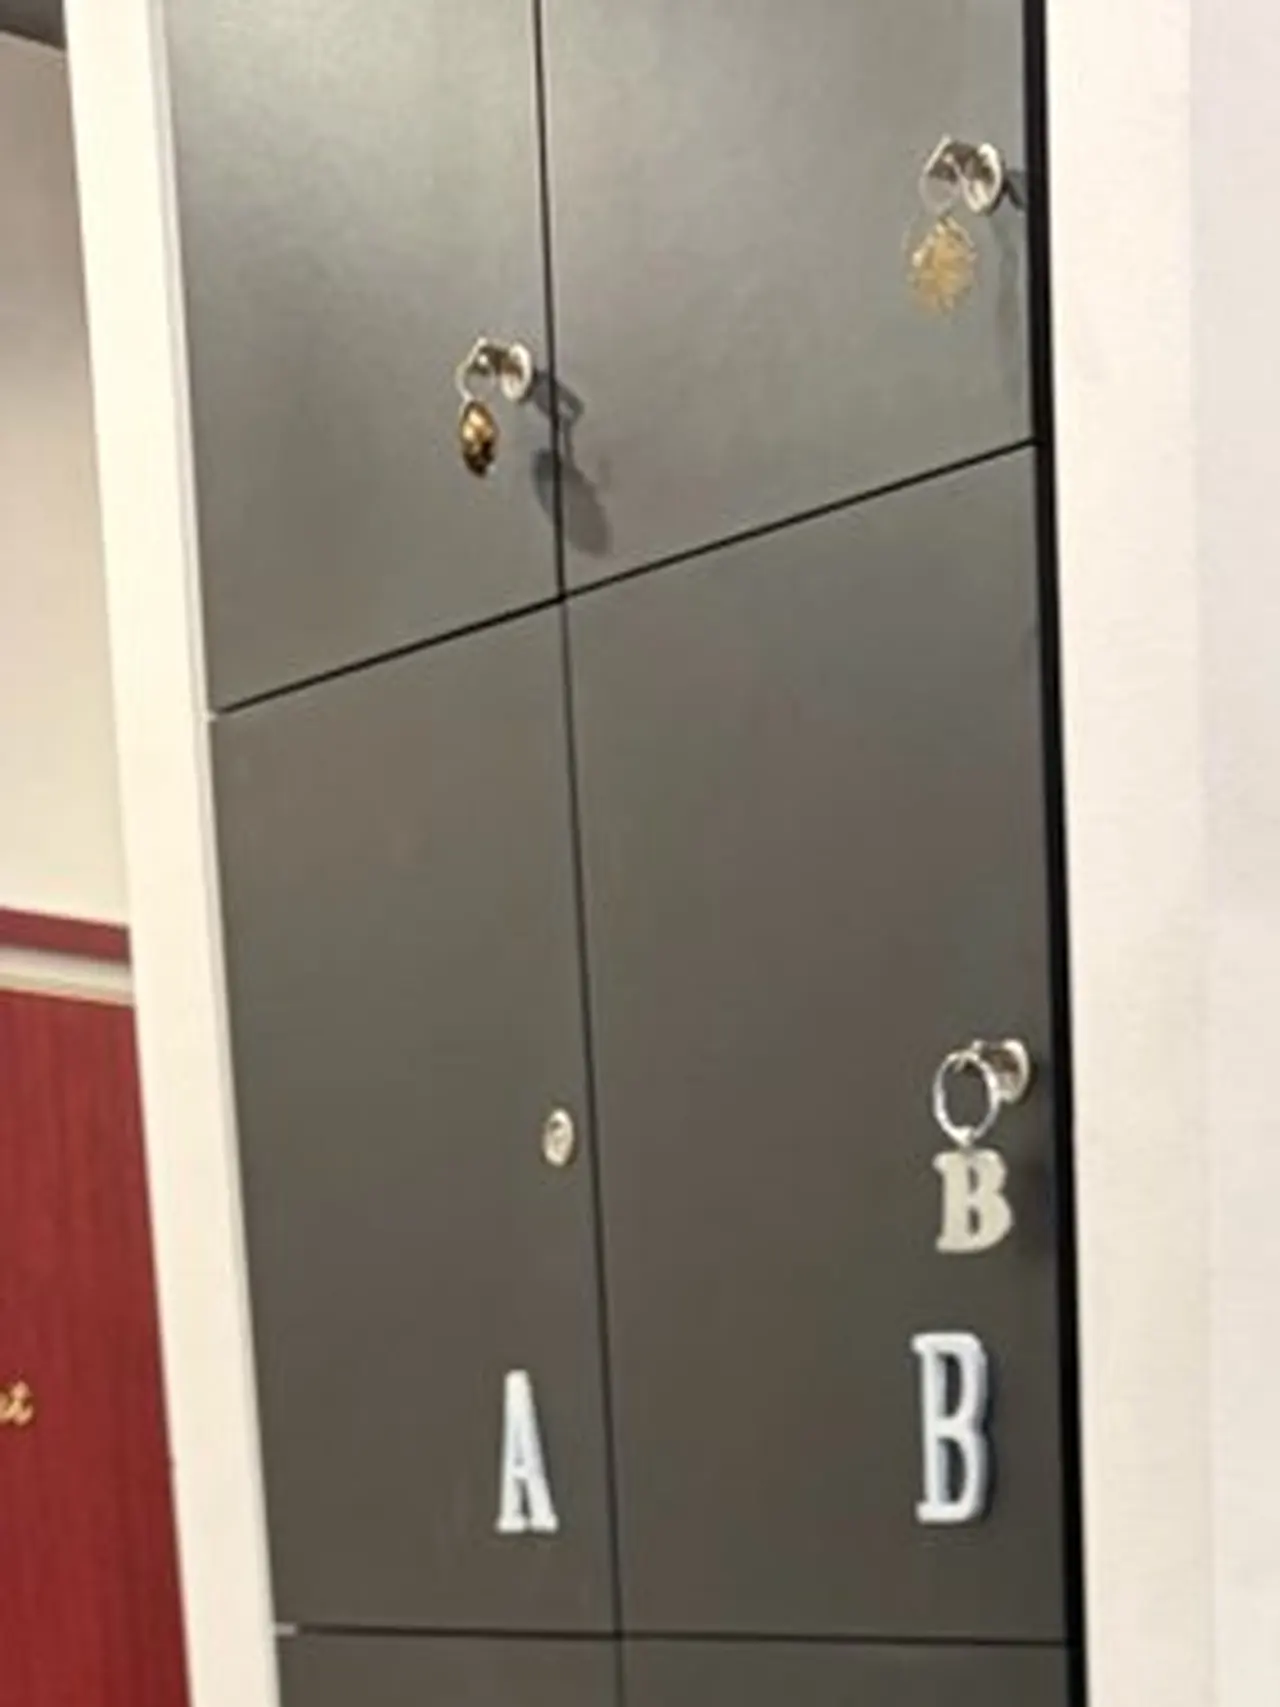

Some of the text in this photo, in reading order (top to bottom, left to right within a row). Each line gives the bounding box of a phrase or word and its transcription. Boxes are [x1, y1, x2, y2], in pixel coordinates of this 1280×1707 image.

[932, 1148, 1014, 1254] B
[495, 1368, 560, 1535] A
[910, 1330, 990, 1524] B
